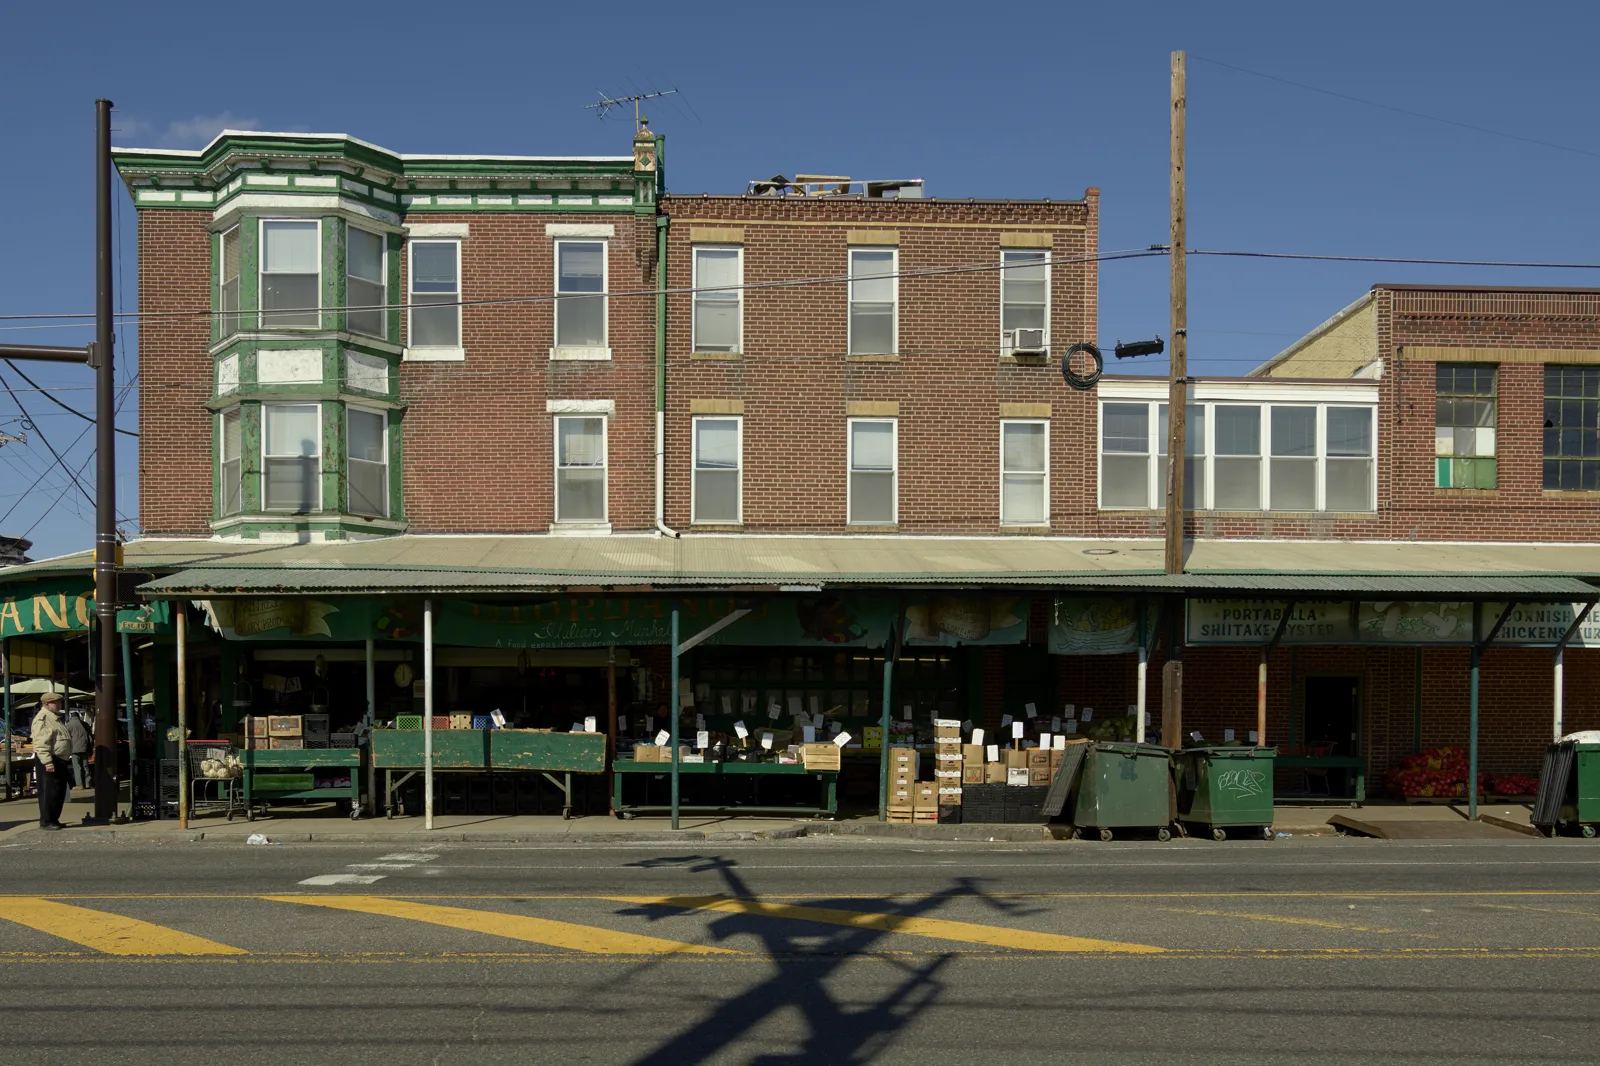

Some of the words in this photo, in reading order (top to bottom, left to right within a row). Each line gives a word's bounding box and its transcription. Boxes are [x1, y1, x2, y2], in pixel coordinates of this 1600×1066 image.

[1222, 608, 1317, 621] PORTABLLA
[1201, 624, 1270, 636] SHIITAKE
[495, 638, 502, 648] A
[508, 639, 526, 648] food
[530, 641, 576, 649] exposition
